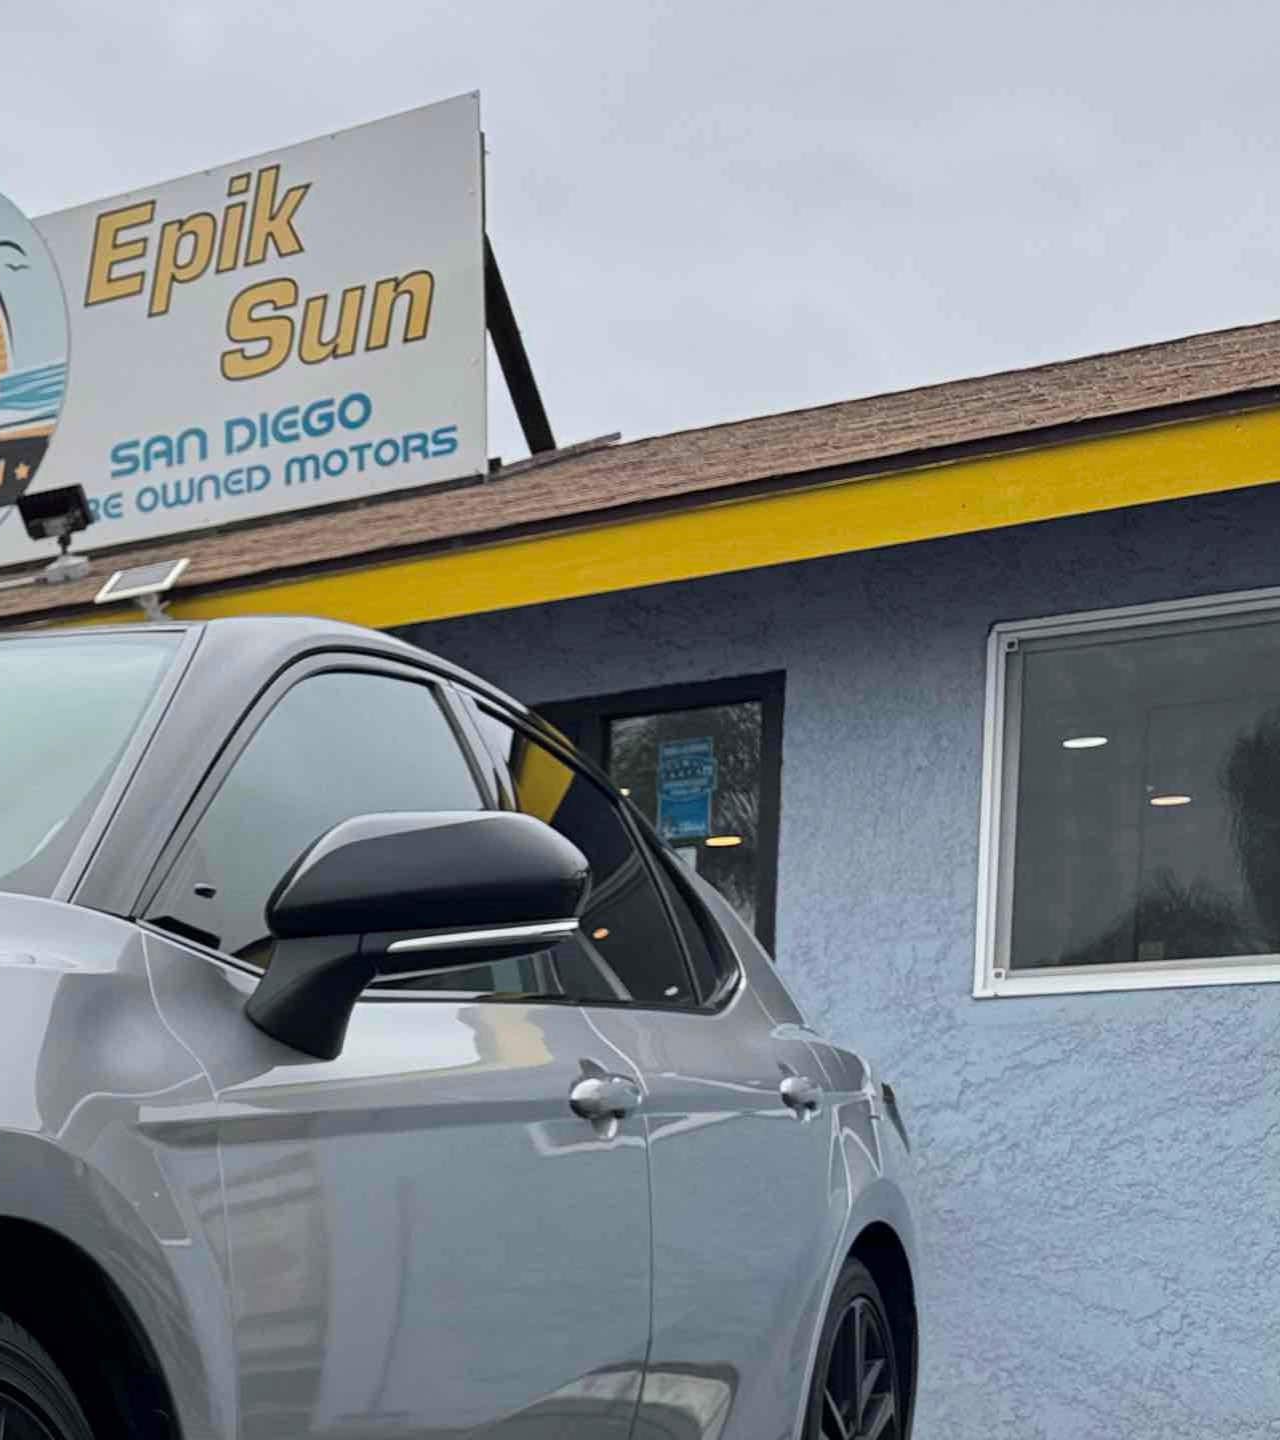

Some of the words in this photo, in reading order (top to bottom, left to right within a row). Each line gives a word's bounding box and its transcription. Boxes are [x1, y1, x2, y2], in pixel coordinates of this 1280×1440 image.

[84, 164, 312, 318] Epik
[220, 270, 434, 380] Sun
[110, 428, 208, 478] SAN
[224, 392, 372, 456] DIEGO
[135, 464, 271, 513] OWNED
[284, 424, 459, 486] MOTORS
